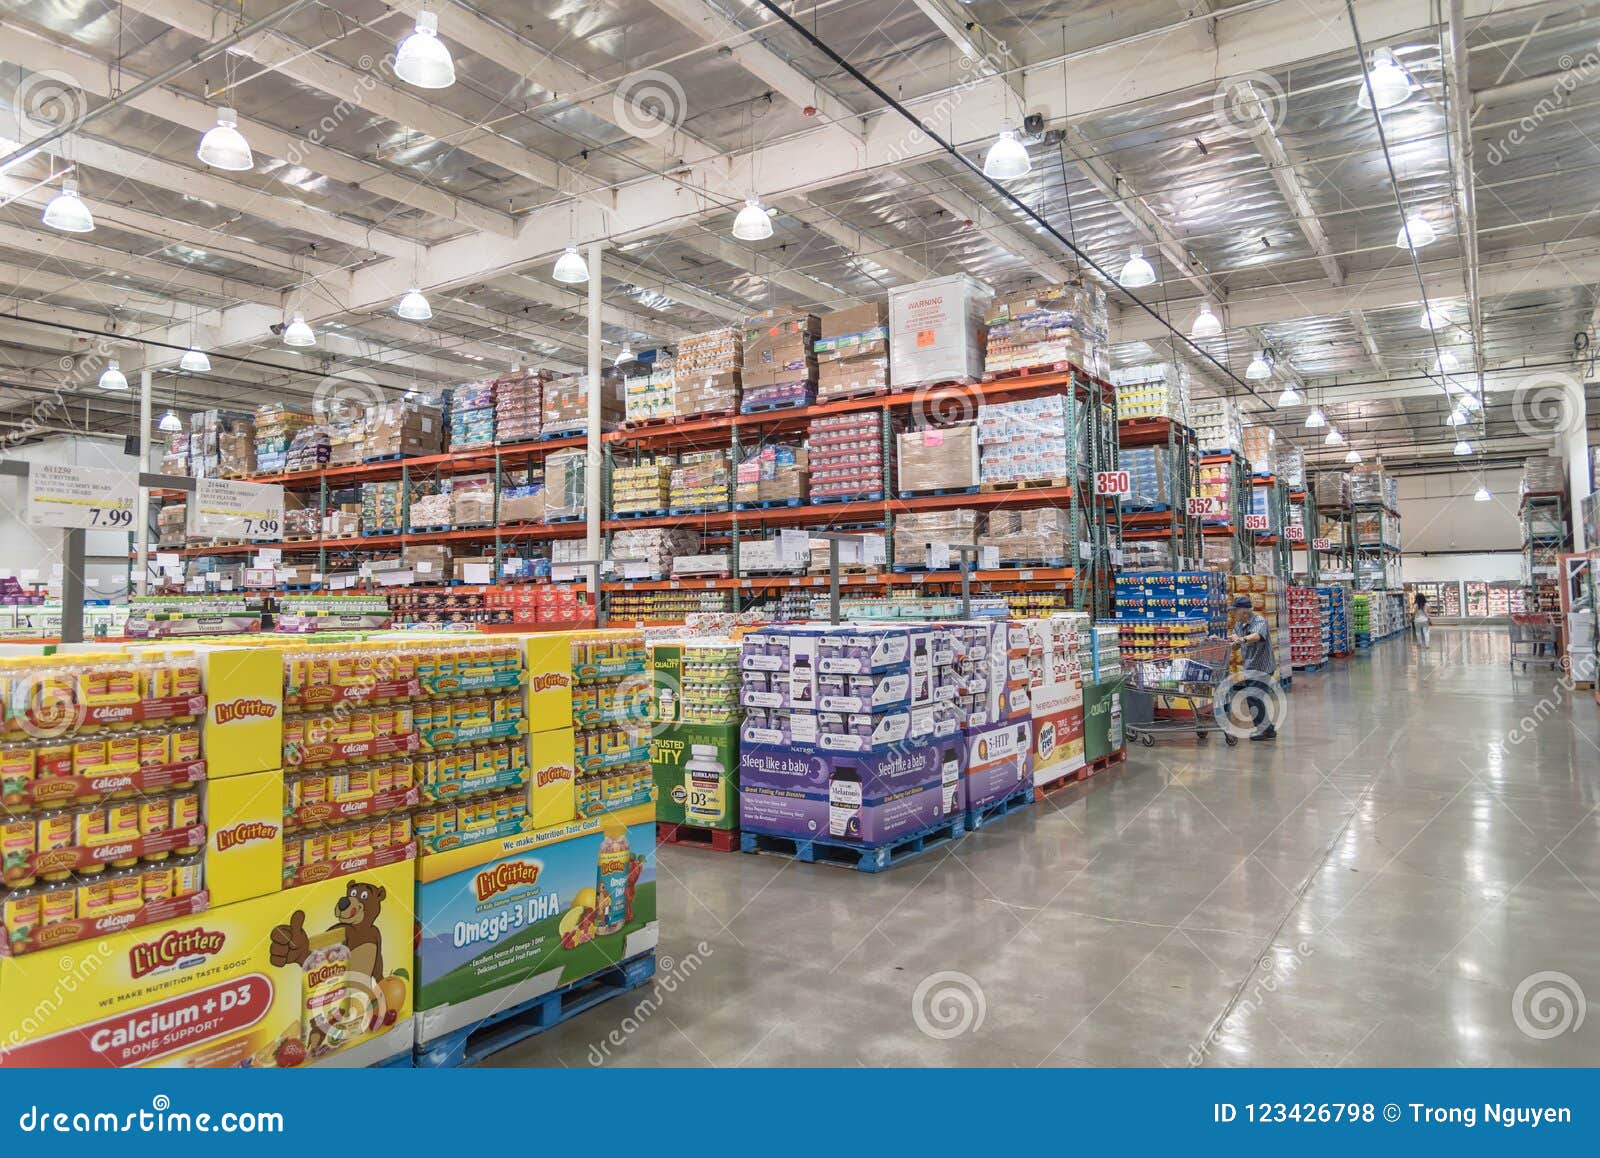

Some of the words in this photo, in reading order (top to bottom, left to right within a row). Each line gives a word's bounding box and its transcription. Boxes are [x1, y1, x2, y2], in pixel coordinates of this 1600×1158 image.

[907, 296, 943, 309] WARNING
[1097, 473, 1128, 493] 350
[1189, 499, 1212, 514] 352
[89, 508, 132, 527] 7.99
[1246, 516, 1267, 529] 354
[243, 519, 278, 534] 7.99
[1285, 528, 1303, 539] 356
[1314, 539, 1329, 548] 358
[93, 707, 132, 718] Calcium
[216, 703, 234, 724] L'il
[234, 699, 277, 718] Critters
[1041, 725, 1053, 737] Move
[989, 733, 1009, 750] 5-HTP
[1042, 736, 1053, 751] Free
[742, 755, 764, 769] Sleep
[766, 756, 779, 770] like
[788, 758, 811, 775] baby.
[879, 761, 895, 777] Sleep
[907, 760, 911, 769] a
[92, 776, 131, 789] Calcium
[691, 791, 706, 806] D3
[217, 829, 234, 851] L'il
[234, 822, 278, 844] Critters
[503, 841, 513, 850] We
[516, 836, 533, 847] make
[536, 829, 563, 842] Nutrition
[566, 825, 580, 834] Taste
[93, 844, 132, 858] Calcium
[477, 873, 496, 899] L'il
[496, 863, 538, 889] Critters
[96, 913, 135, 929] Calcium
[454, 905, 523, 947] Omega-3
[528, 893, 560, 922] DHA
[131, 944, 159, 976] L'il
[160, 928, 224, 961] Critters
[99, 998, 114, 1007] WE
[117, 989, 143, 1002] MAKE
[146, 975, 193, 993] NUTRITION
[196, 966, 221, 980] TASTE
[90, 1003, 199, 1053] Calcium
[203, 1000, 216, 1014] +
[220, 984, 251, 1012] D3
[122, 1038, 159, 1058] BONE
